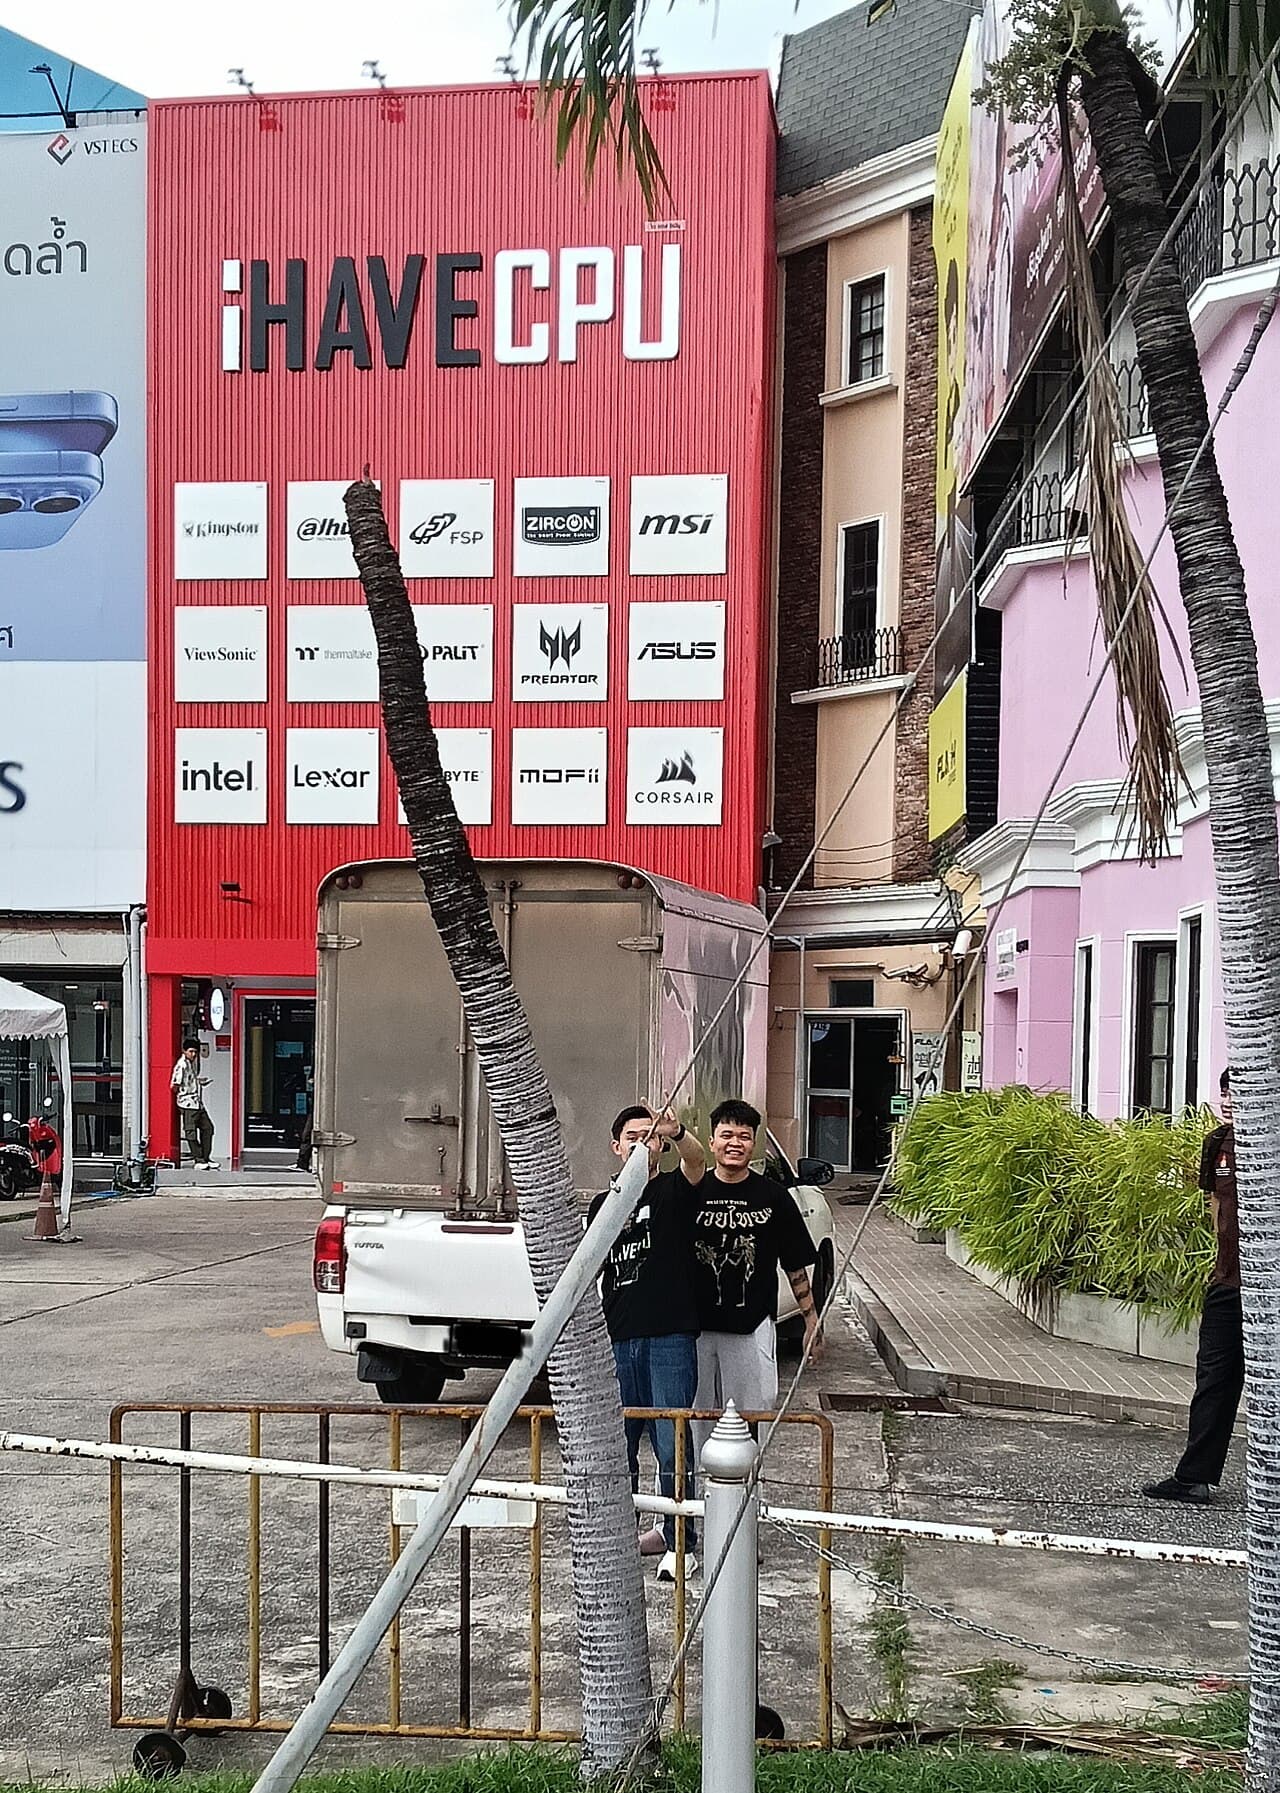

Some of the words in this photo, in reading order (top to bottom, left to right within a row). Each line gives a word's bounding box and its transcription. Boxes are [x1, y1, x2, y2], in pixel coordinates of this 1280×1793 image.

[84, 138, 138, 155] VSTECS
[222, 243, 682, 373] iHAVECPU
[197, 520, 259, 537] Kingston
[527, 513, 595, 532] ZIRCON
[638, 513, 718, 535] msi
[450, 531, 484, 545] FSP
[184, 646, 257, 661] ViewSonic
[637, 641, 717, 660] ASUS
[521, 674, 599, 685] PREDATOR
[293, 764, 371, 787] Lexar
[634, 791, 714, 804] CORSAIR
